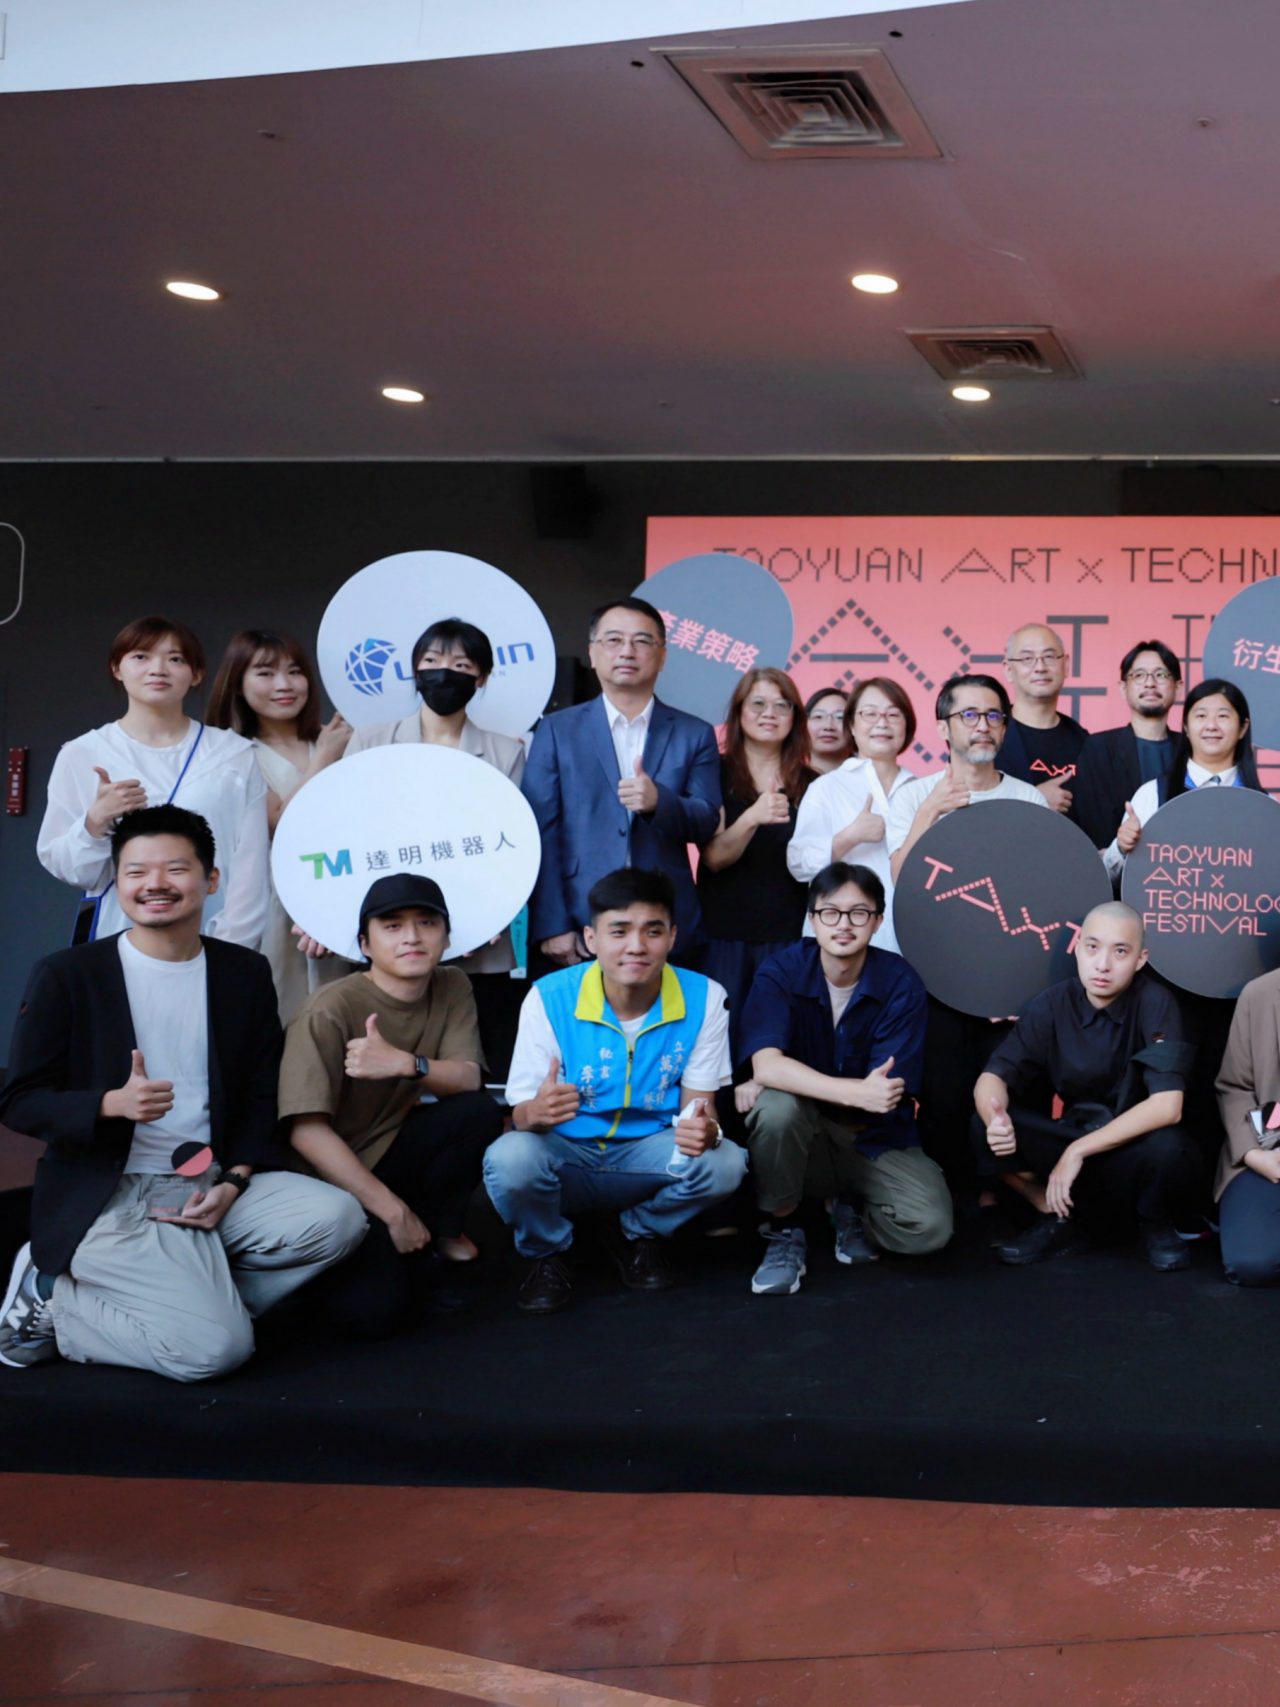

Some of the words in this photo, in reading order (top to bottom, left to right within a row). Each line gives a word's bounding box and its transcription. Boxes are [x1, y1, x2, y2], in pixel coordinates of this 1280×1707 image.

[712, 547, 923, 583] OYUAN
[940, 547, 1061, 584] ART
[298, 848, 354, 880] TM
[365, 831, 516, 872] 達明機器人
[1146, 842, 1253, 868] TAOYUAN
[1142, 865, 1205, 888] ART
[1142, 911, 1268, 937] FESTIVAL
